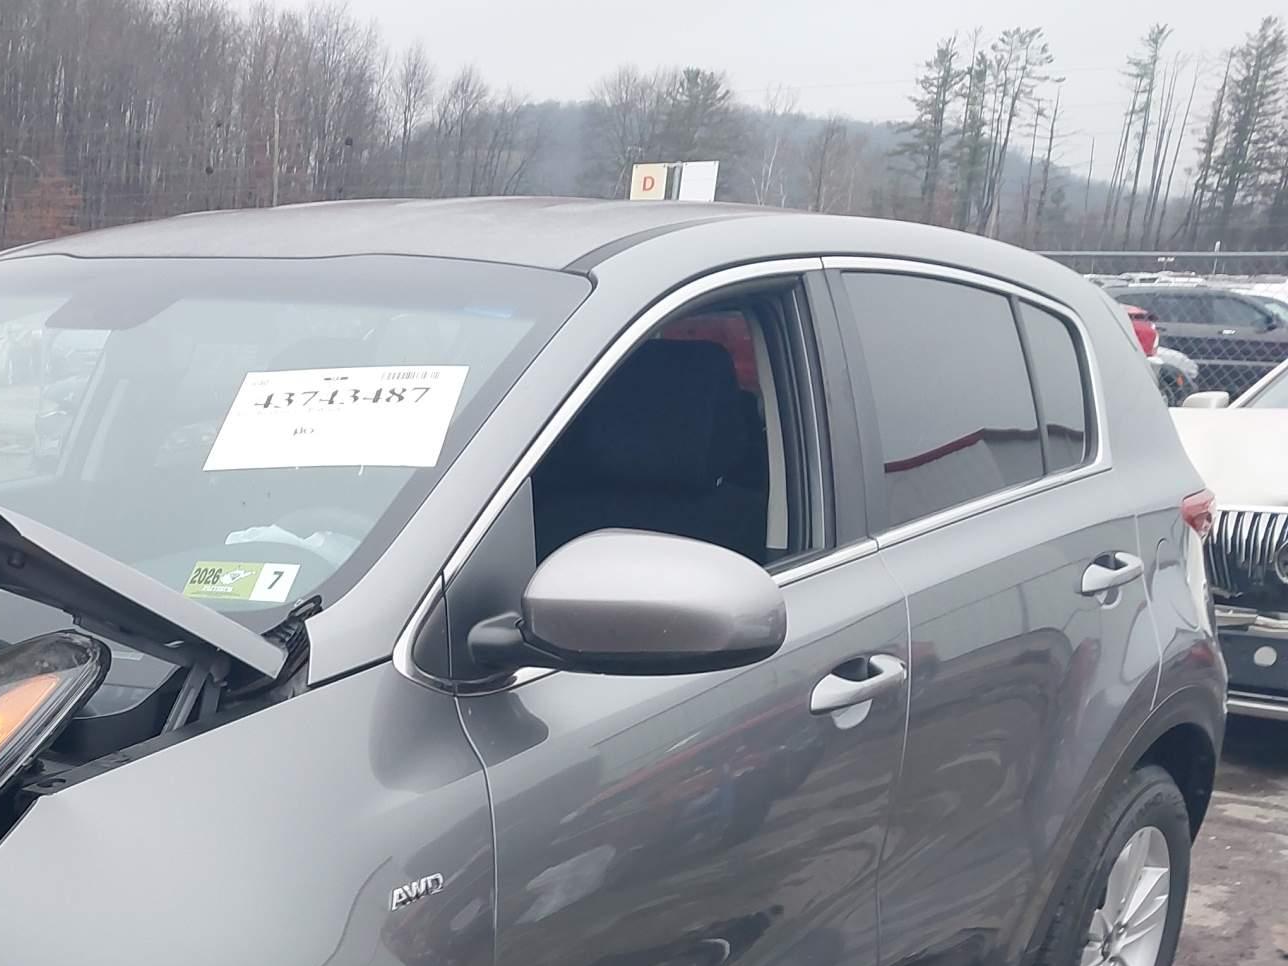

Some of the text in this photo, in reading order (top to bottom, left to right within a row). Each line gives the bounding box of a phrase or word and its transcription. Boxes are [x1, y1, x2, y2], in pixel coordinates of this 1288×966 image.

[642, 175, 656, 192] D
[254, 386, 432, 409] 43743487
[189, 567, 285, 590] 2026 7
[391, 872, 444, 911] AWD
